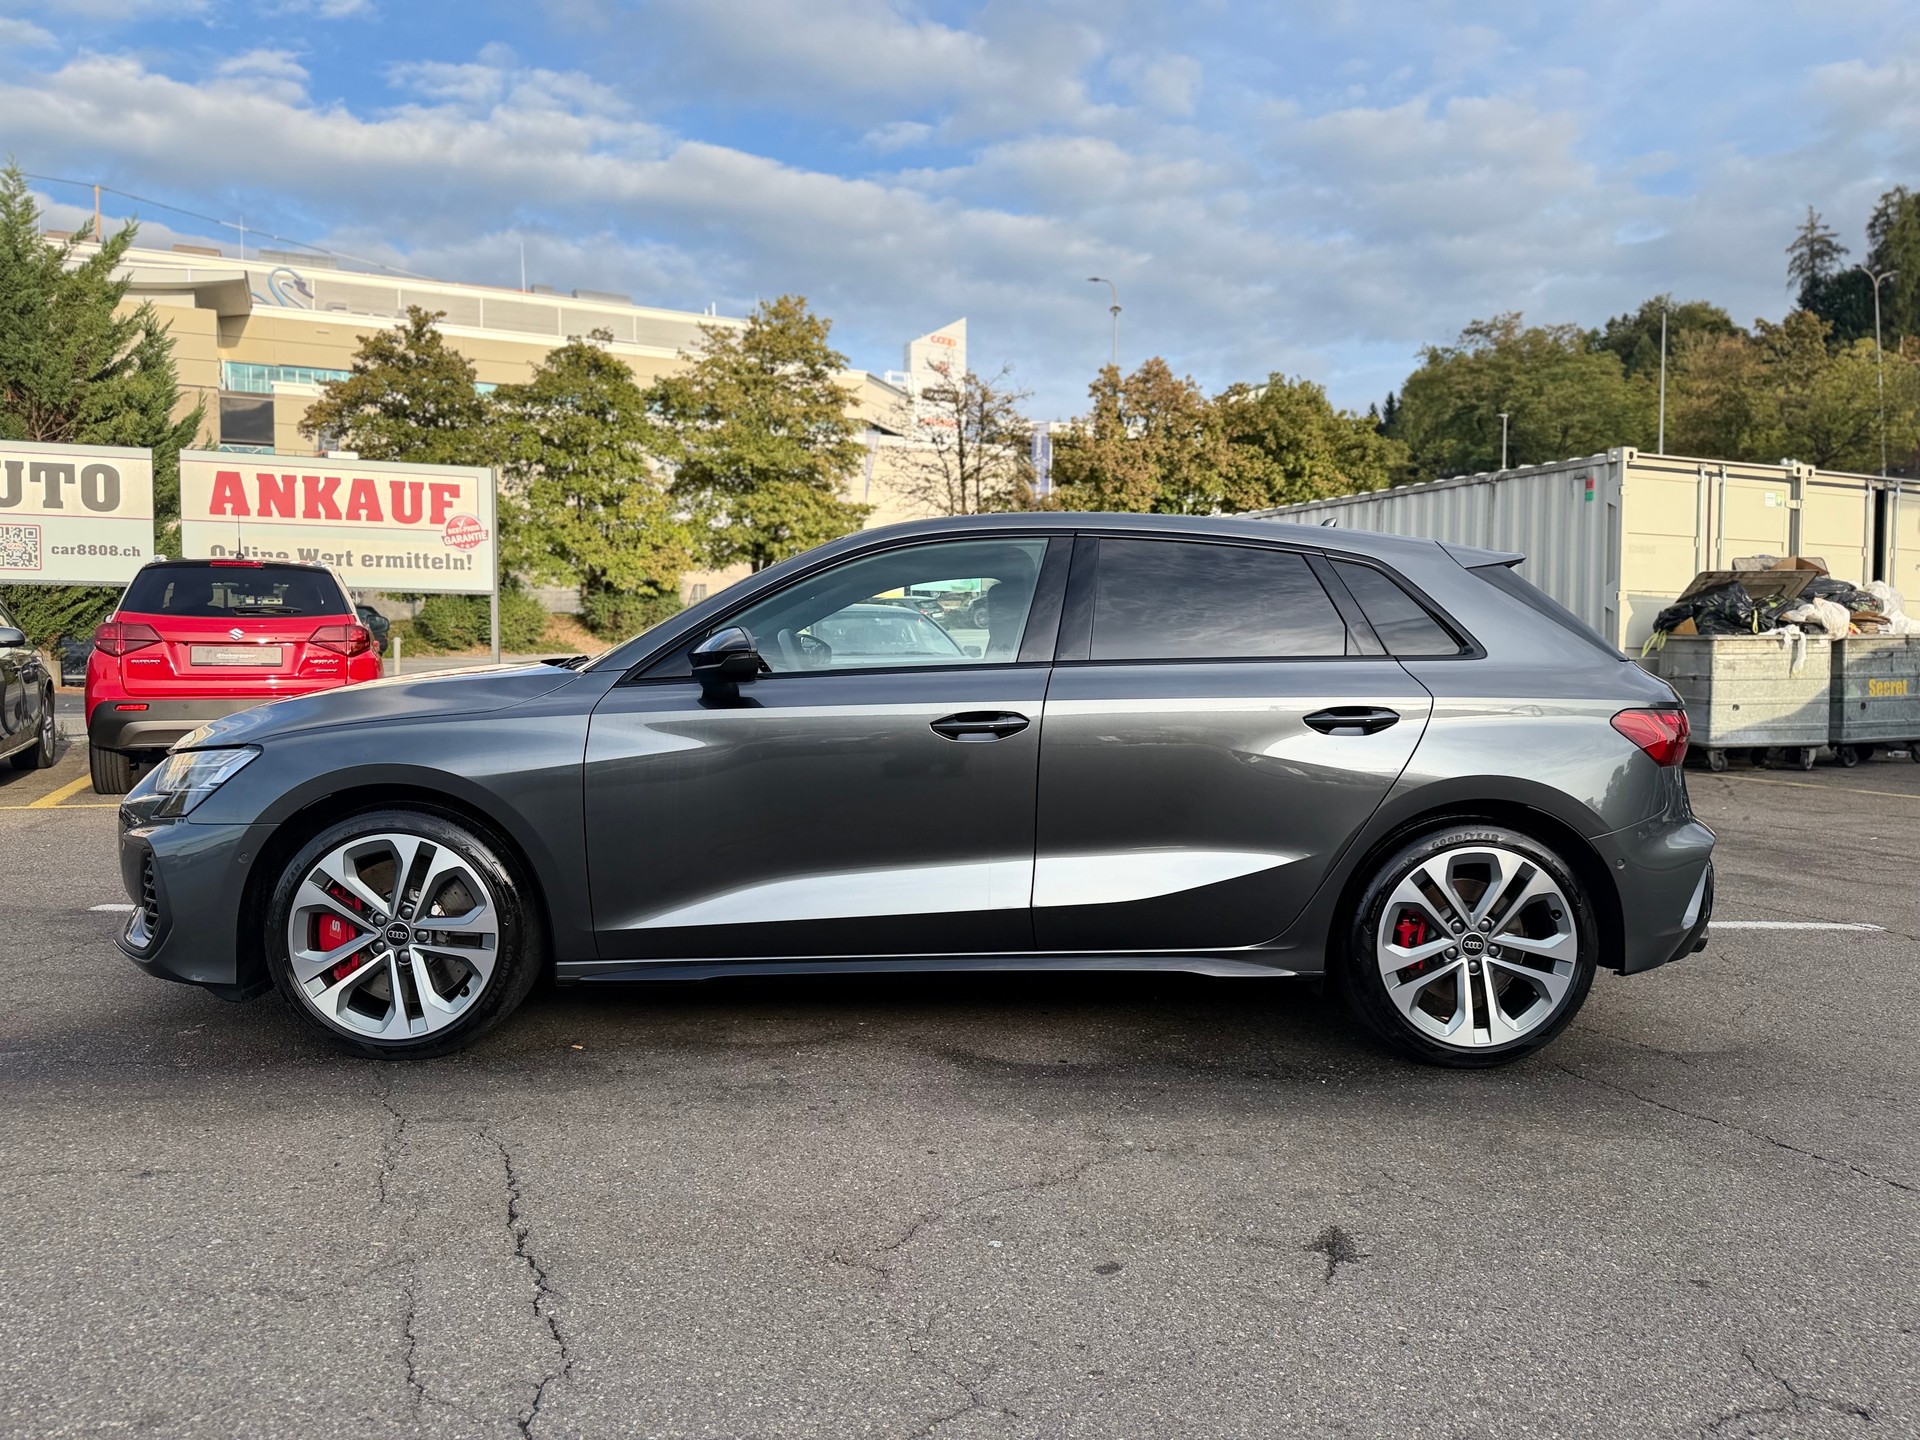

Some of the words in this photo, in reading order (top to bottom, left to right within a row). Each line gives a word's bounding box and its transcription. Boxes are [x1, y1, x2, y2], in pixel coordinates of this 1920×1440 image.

[209, 471, 460, 525] ANKAUF
[443, 531, 488, 545] GARANTIE
[51, 544, 141, 557] car8808.ch
[361, 552, 472, 571] ermitteln!
[1868, 678, 1908, 697] Secret
[1432, 832, 1500, 849] GOODYEAR
